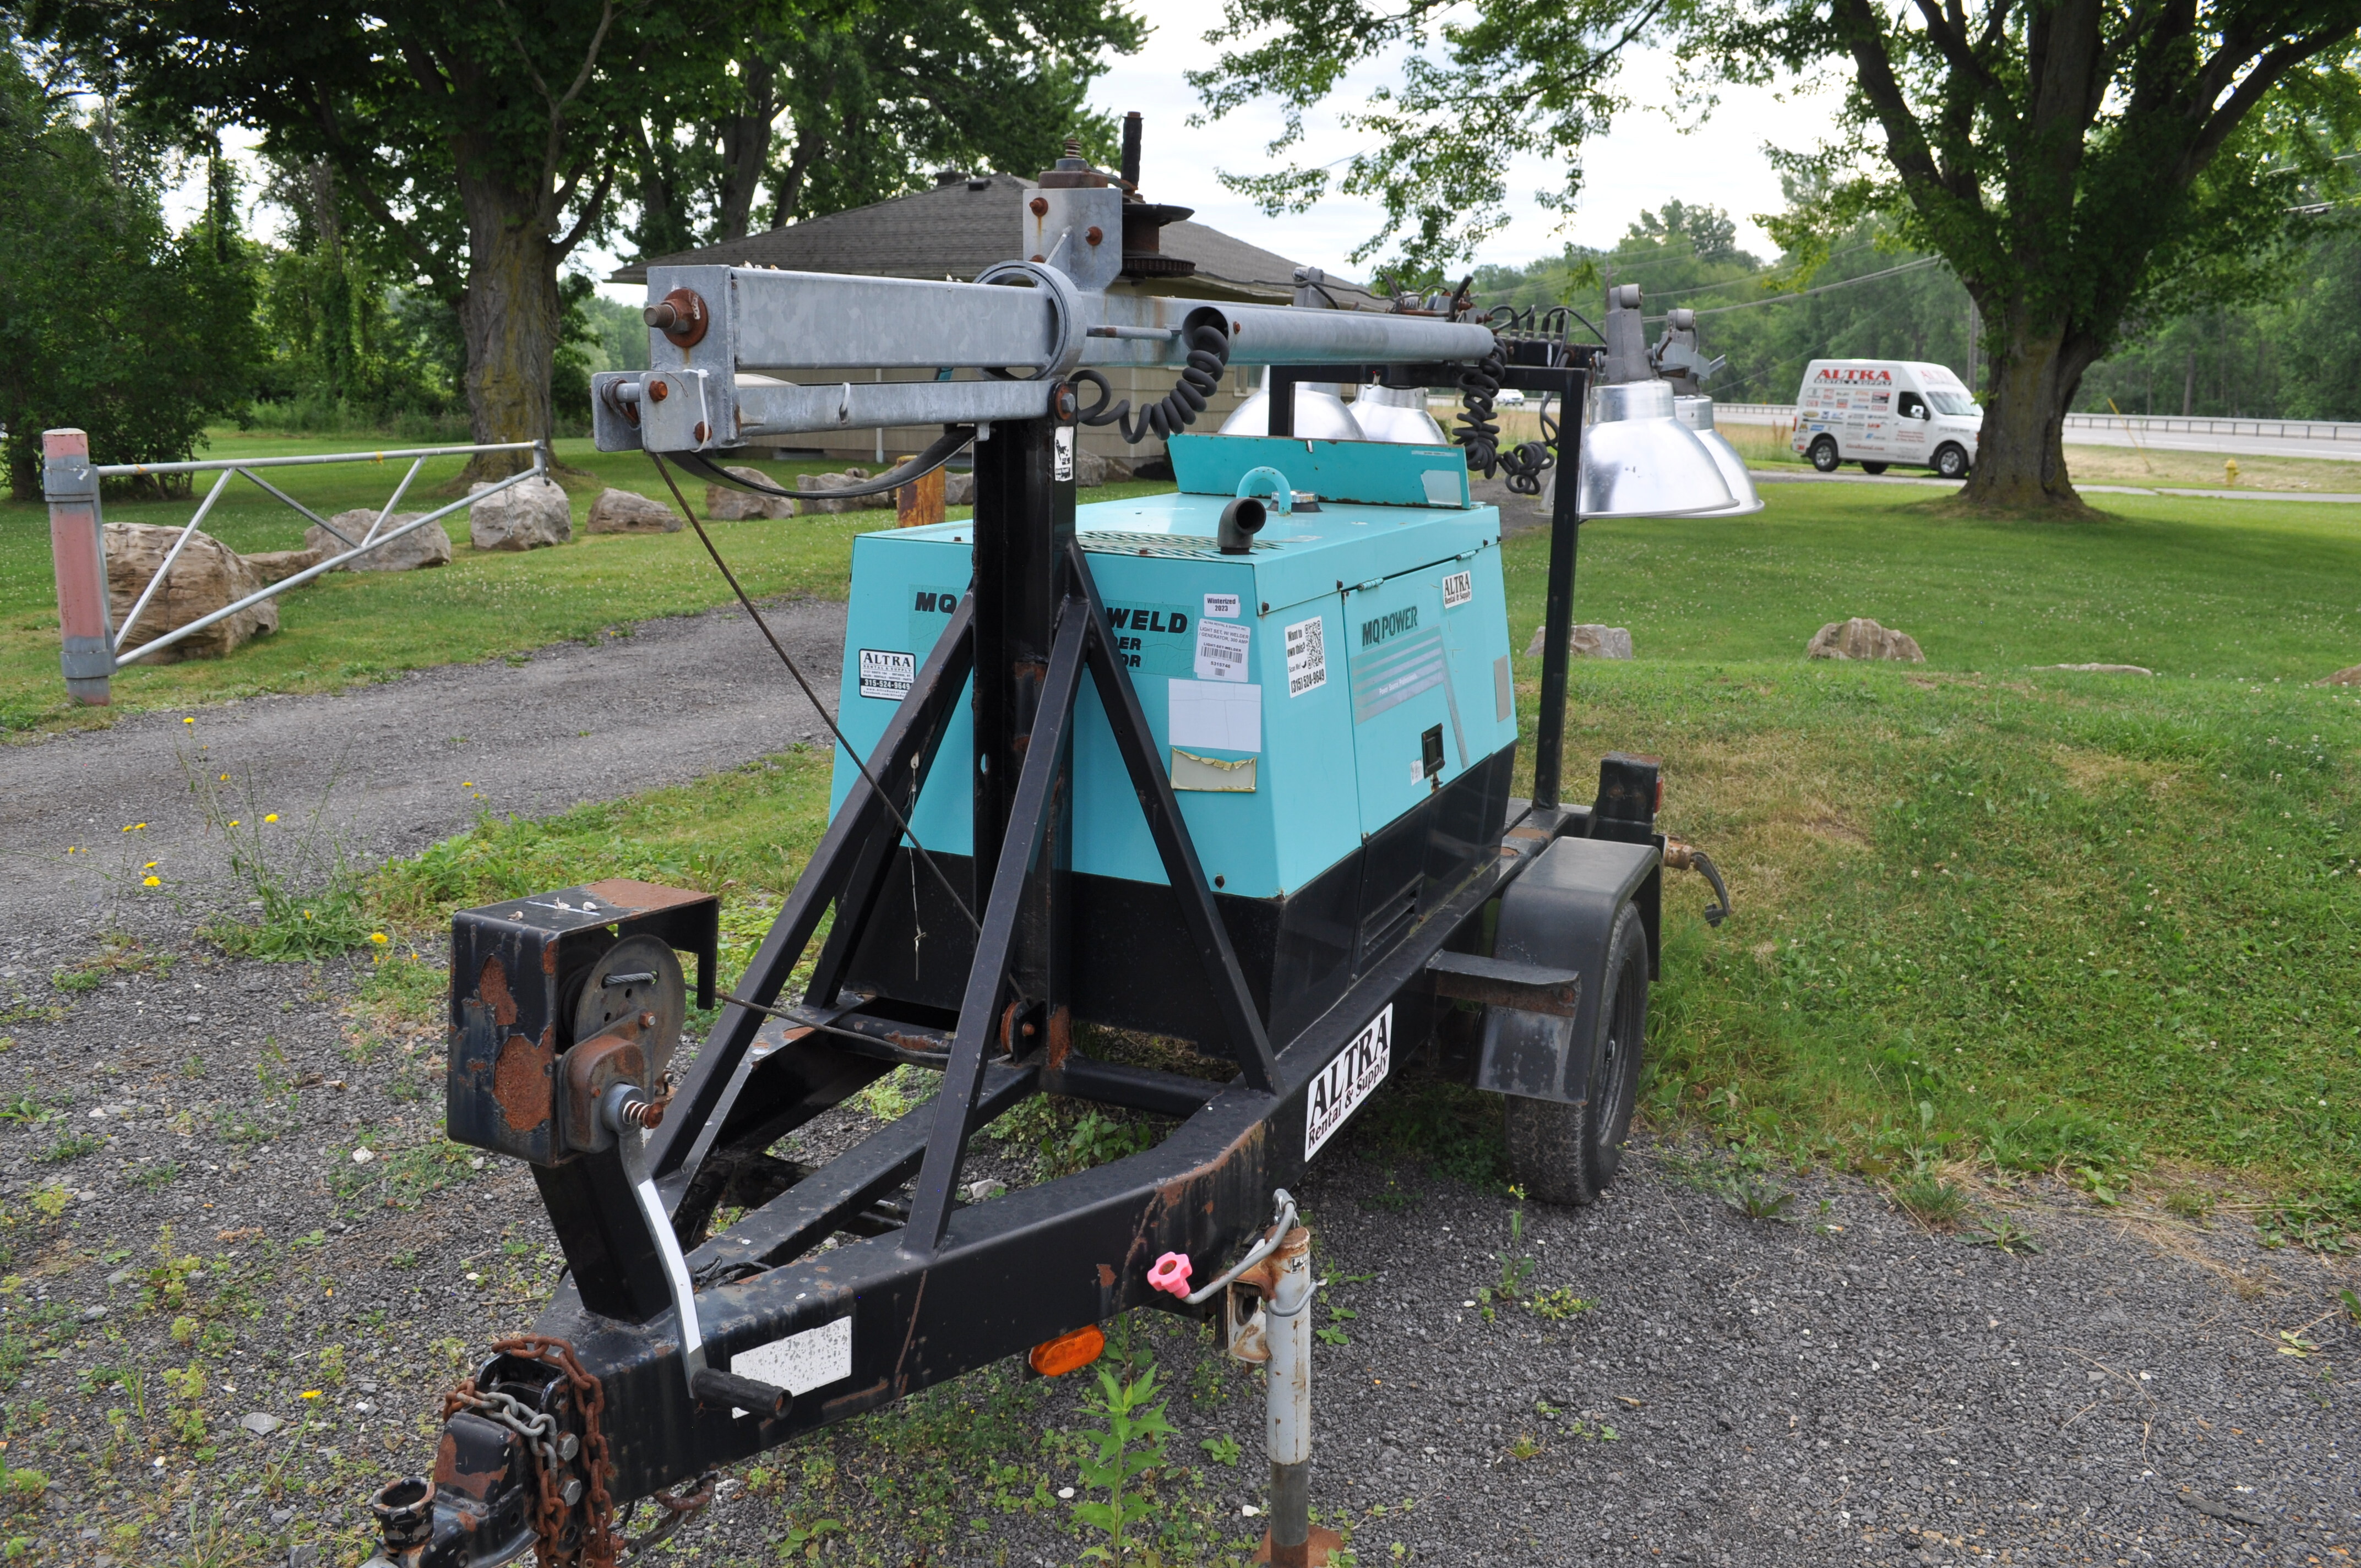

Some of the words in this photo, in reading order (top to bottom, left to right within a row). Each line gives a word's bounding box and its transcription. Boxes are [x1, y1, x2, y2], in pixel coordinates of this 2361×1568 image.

[1817, 369, 1891, 380] ALTRA
[1445, 573, 1470, 597] ALTRA
[915, 592, 957, 615] MQ
[1287, 630, 1298, 641] Want
[1298, 629, 1302, 638] to
[1362, 618, 1380, 646] MQ
[1382, 606, 1418, 639] POWER
[1204, 643, 1242, 652] LIGHT-SET-WELDER
[1287, 647, 1296, 657] own
[1296, 642, 1305, 655] this?
[863, 652, 911, 667] ALTRA
[864, 679, 910, 689] 315-524-9649
[1291, 677, 1303, 693] (315)
[1303, 668, 1325, 688] 524-9649
[1309, 1013, 1388, 1130] ALTRA
[1308, 1099, 1342, 1150] Rental
[1345, 1090, 1353, 1109] &
[1356, 1052, 1388, 1098] Supply
